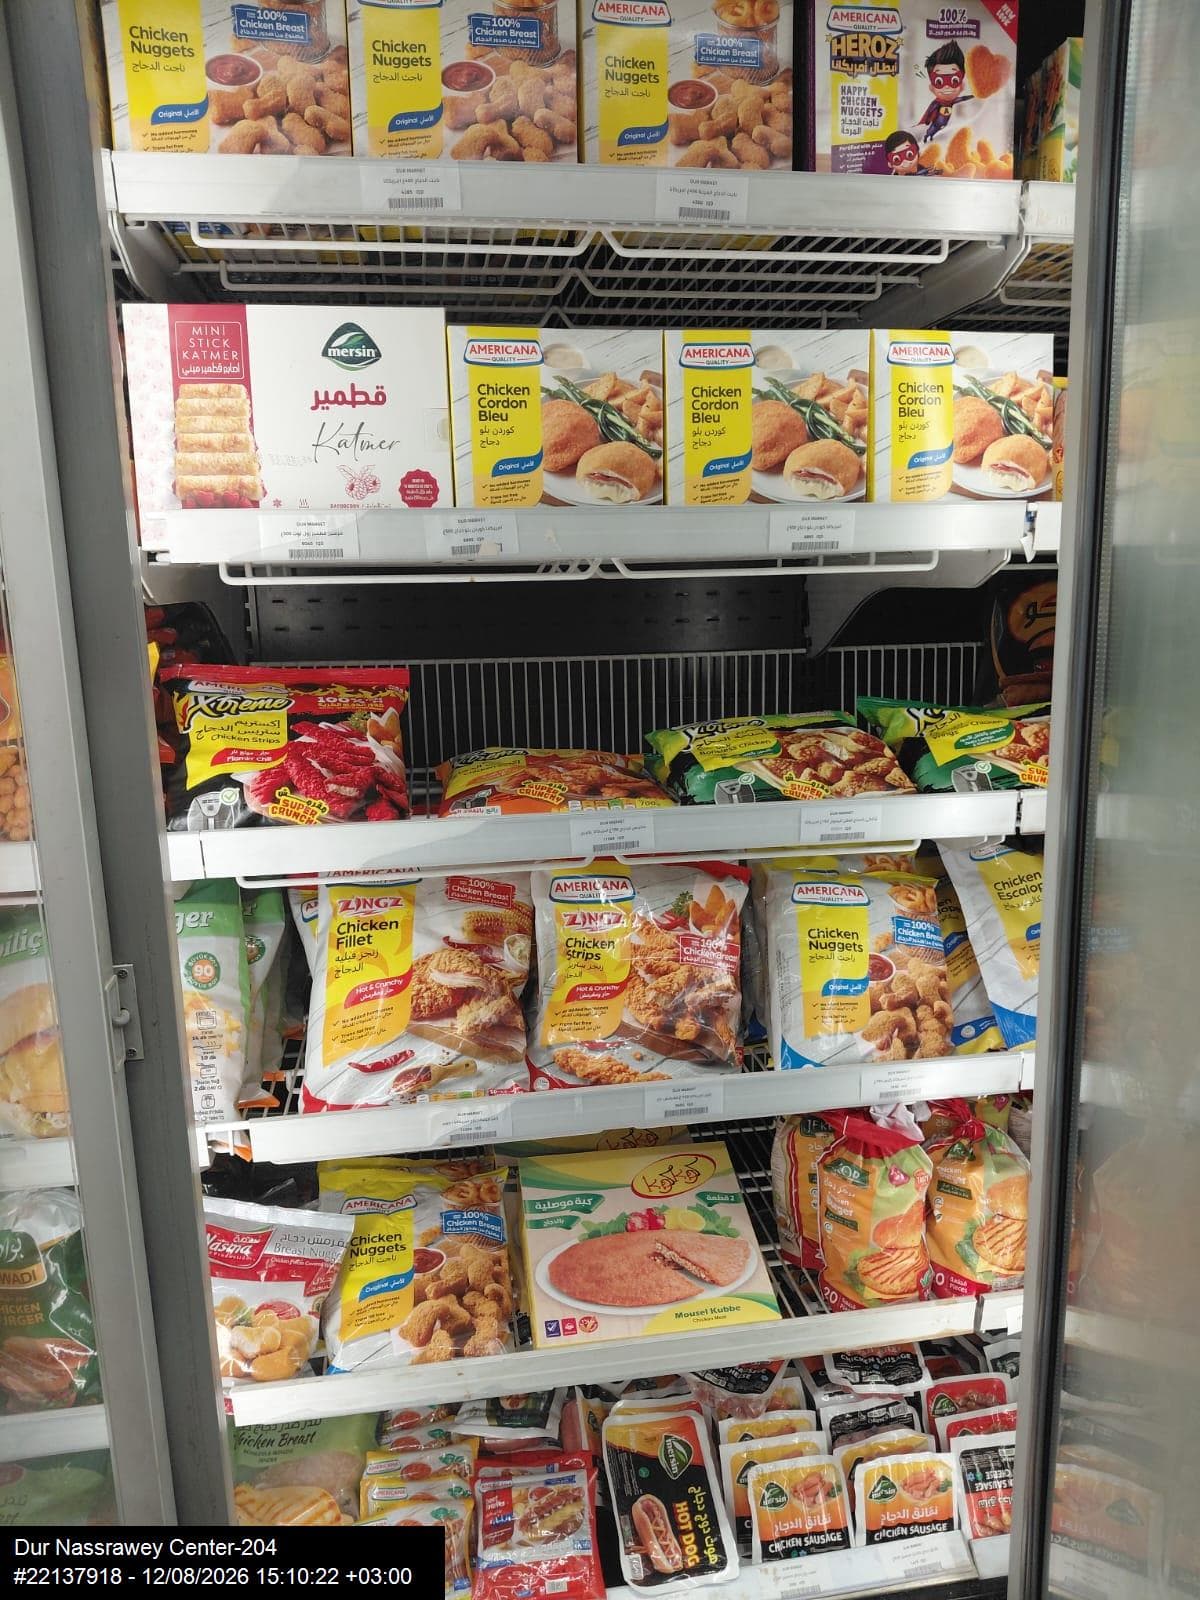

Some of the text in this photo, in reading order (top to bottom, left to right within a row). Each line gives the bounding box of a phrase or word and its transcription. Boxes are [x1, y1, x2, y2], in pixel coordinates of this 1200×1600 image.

[257, 10, 288, 21] 100%
[598, 4, 665, 16] AMERICANA
[939, 9, 968, 22] 100%
[492, 18, 520, 28] 100%
[832, 10, 896, 24] AMERICANA
[240, 20, 305, 32] Chicken Breast
[129, 25, 188, 42] Chicken
[475, 27, 537, 38] Chicken Breast
[372, 40, 426, 53] Chicken
[717, 37, 743, 47] 100%
[832, 34, 899, 58] HEROZ
[131, 40, 195, 58] Nuggets
[701, 47, 758, 57] Chicken Breast
[132, 61, 160, 73] الدجاج
[373, 54, 432, 68] Nuggets
[605, 56, 655, 70] Chicken
[373, 72, 399, 83] الدجاج
[605, 70, 659, 84] Nuggets
[605, 88, 628, 98] الدجاج
[840, 85, 868, 97] HAPPY
[841, 96, 877, 107] CHICKEN
[158, 111, 183, 119] Original
[841, 107, 883, 118] NUGGETS
[395, 118, 418, 126] Original
[624, 132, 646, 140] Original
[189, 338, 230, 348] STICK
[182, 351, 239, 361] KATMER
[328, 345, 376, 357] mersin
[470, 345, 537, 355] AMERICANA
[685, 348, 750, 358] AMERICANA
[892, 346, 950, 356] AMERICANA
[477, 383, 530, 396] Chicken
[692, 386, 741, 398] Chicken
[898, 382, 944, 393] Chicken
[310, 383, 387, 411] قطمير
[478, 397, 527, 409] Cordon
[898, 395, 941, 406] Cordon
[692, 399, 739, 410] Cordon
[478, 410, 508, 422] Bleu
[692, 412, 720, 424] Bleu
[899, 407, 924, 418] Bleu
[480, 425, 515, 436] كوردن بلو
[692, 427, 726, 437] كوردن بلو
[899, 422, 929, 431] كوردن بلو
[312, 422, 401, 464] Katmer
[480, 438, 500, 448] دجاج
[899, 434, 916, 443] دجاج
[692, 440, 711, 450] دجاج
[499, 463, 519, 471] Original
[709, 463, 729, 471] Original
[183, 696, 289, 731] Xtreme
[195, 725, 233, 740] الدجاج
[211, 734, 250, 742] Chicken
[739, 740, 771, 748] Chicken
[526, 783, 559, 794] SUPER
[787, 782, 823, 797] SUPER
[519, 788, 562, 803] CRUNCHY
[282, 799, 318, 817] SUPER
[271, 806, 317, 824] CRUNCH
[469, 878, 495, 890] 100%
[555, 881, 628, 893] AMERICANA
[994, 872, 1042, 891] Chicken
[452, 886, 483, 896] Chicken
[484, 890, 510, 901] Breast
[797, 886, 865, 898] AMERICANA
[338, 896, 404, 912] ZINGZ
[337, 920, 399, 935] Chicken
[911, 921, 934, 932] 100%
[807, 928, 859, 941] Chicken
[898, 928, 925, 938] Chicken
[336, 934, 373, 951] Fillet
[566, 937, 616, 950] Chicken
[808, 940, 863, 954] Nuggets
[566, 949, 601, 962] Strips
[808, 952, 835, 963] الدجاج
[194, 964, 214, 977] 90
[334, 964, 364, 979] الدجاج
[356, 984, 369, 994] Hot
[374, 978, 403, 990] Crunchy
[576, 984, 619, 992] Hot Crunchy
[828, 983, 848, 992] Original
[345, 1197, 412, 1210] AMERICANA
[534, 1197, 593, 1211] كبة موصلية
[462, 1211, 489, 1221] 100%
[478, 1221, 501, 1232] Breast
[350, 1233, 402, 1247] Chicken
[274, 1242, 305, 1255] Breast
[350, 1244, 407, 1260] Nuggets
[349, 1256, 374, 1272] الدجاج
[365, 1282, 388, 1294] Original
[823, 1286, 838, 1304] 20
[675, 1305, 741, 1320] Mousel Kubbe
[839, 1353, 912, 1365] CHICKEN SAUSAGE
[278, 1431, 316, 1447] Breast
[665, 1438, 678, 1474] mersin
[872, 1488, 897, 1499] mersin
[764, 1496, 786, 1505] mersin
[881, 1506, 938, 1525] نقانق الدجاج
[774, 1519, 802, 1537] الدجاج
[874, 1523, 947, 1540] CHICKEN SAUSAGE
[676, 1501, 700, 1568] HOT DOG
[769, 1532, 843, 1553] CHICKEN SAUSAGE
